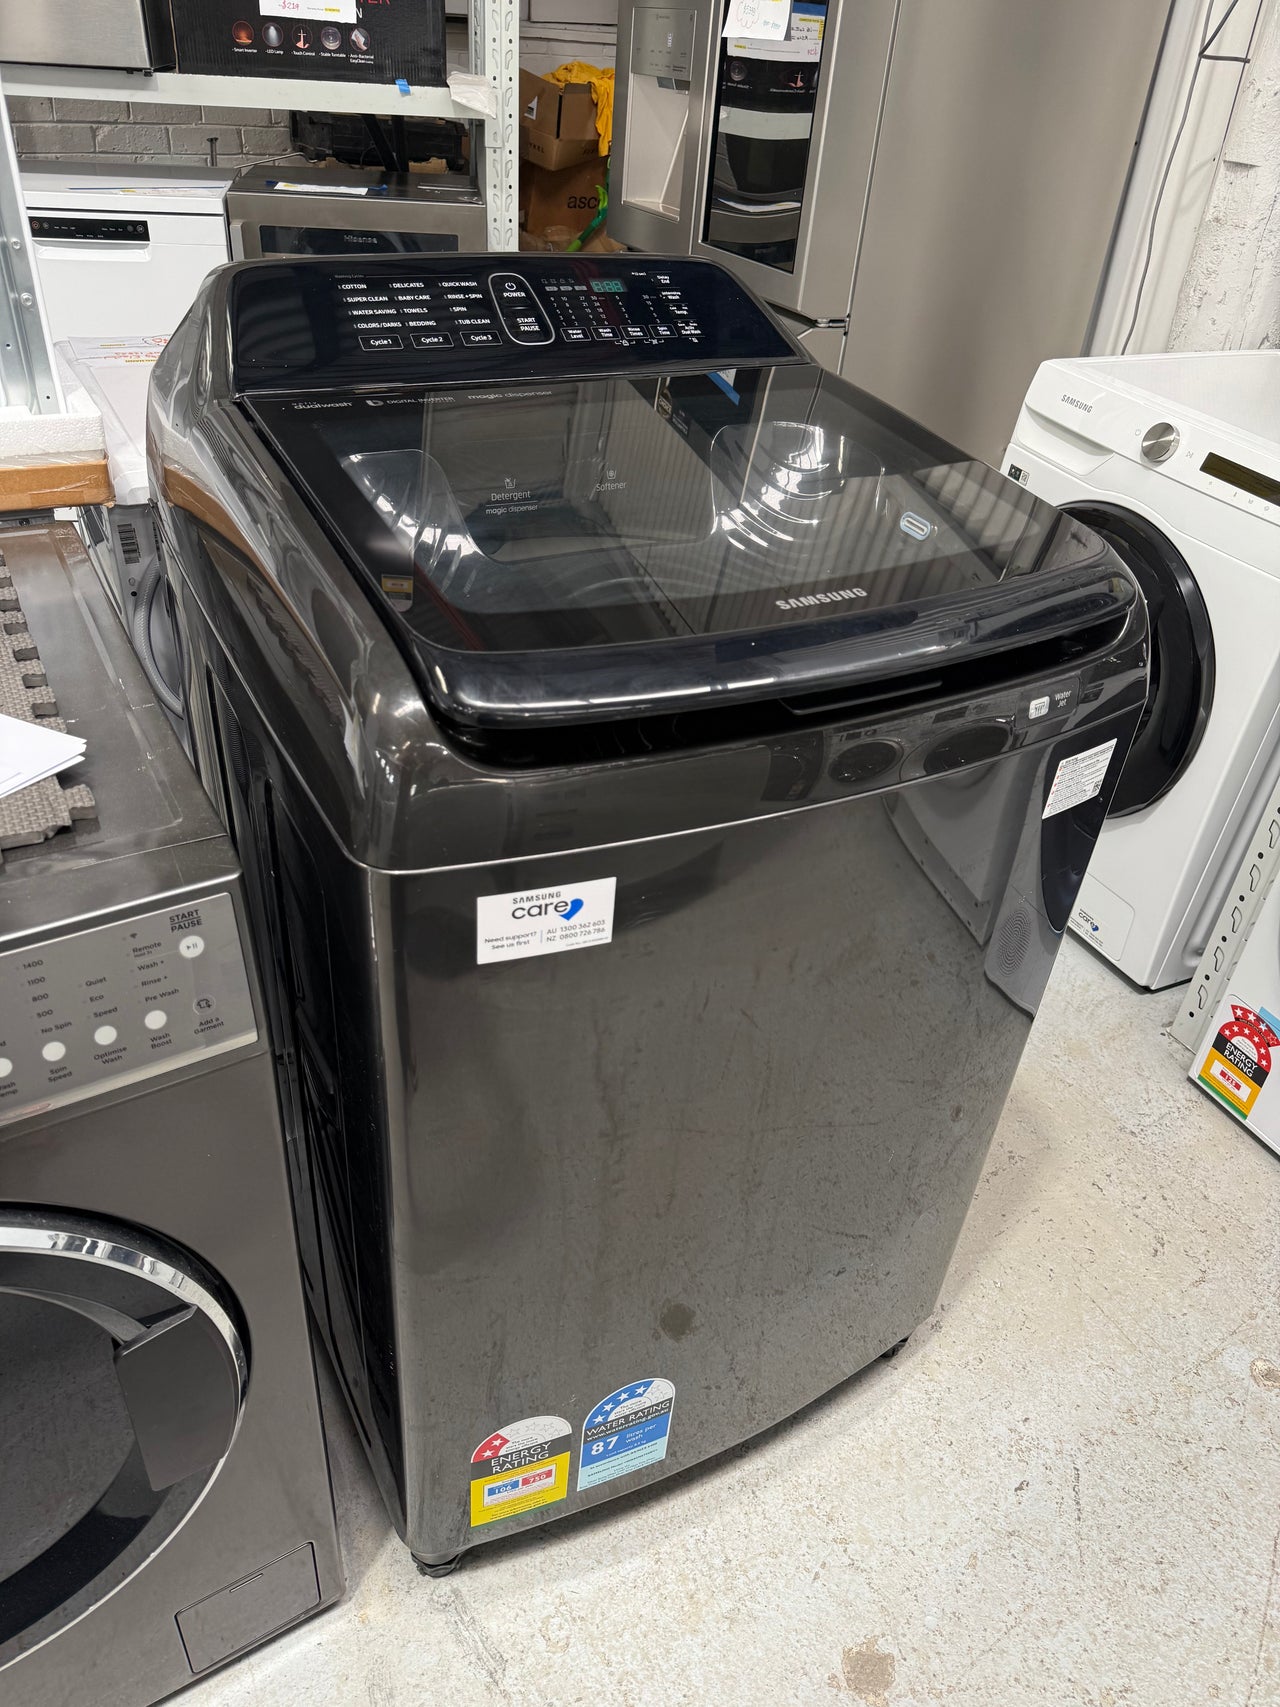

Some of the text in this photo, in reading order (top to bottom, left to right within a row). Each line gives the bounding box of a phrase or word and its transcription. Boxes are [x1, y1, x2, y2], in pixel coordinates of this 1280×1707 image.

[567, 195, 600, 209] asc
[370, 338, 388, 346] Cycle
[421, 336, 438, 344] Cycle
[470, 334, 487, 342] Cycle
[417, 396, 455, 404] INVERTER
[504, 390, 553, 399] dispenser
[1061, 394, 1093, 414] SAMSUNG
[596, 482, 627, 492] Softener
[491, 490, 531, 501] Detergent
[485, 504, 538, 516] magic dispenser
[775, 587, 869, 610] SAMSUNG
[1055, 690, 1072, 701] Water
[1057, 699, 1067, 708] Jet
[512, 891, 562, 905] SAMSUNG
[169, 908, 201, 923] START
[511, 900, 569, 920] care
[171, 918, 203, 933] PAUSE
[559, 924, 577, 933] 1300
[578, 922, 591, 930] 362
[592, 919, 606, 927] 603
[484, 931, 537, 944] Need support?
[559, 932, 578, 940] 0800
[579, 929, 592, 937] 726
[132, 941, 162, 954] Remote
[516, 939, 530, 947] first
[22, 959, 44, 970] 1400
[137, 961, 159, 972] Wash
[27, 976, 46, 987] 1100
[85, 976, 107, 987] Quiet
[141, 977, 162, 987] Rinse
[31, 993, 49, 1002] 800
[89, 993, 104, 1003] Eco
[144, 988, 180, 1003] Pre Wash
[93, 1006, 118, 1019] Speed
[41, 1020, 73, 1034] No Spin
[193, 1020, 225, 1035] Garment
[199, 1017, 214, 1027] Add
[150, 1032, 171, 1043] Wash
[150, 1039, 172, 1050] Boost
[93, 1046, 128, 1061] Optimise
[1225, 1042, 1258, 1071] ENERGY
[101, 1054, 123, 1065] Wash
[1223, 1049, 1254, 1078] RATING
[49, 1065, 68, 1075] Spin
[47, 1071, 73, 1083] Speed
[0, 1089, 19, 1098] emp
[586, 1400, 670, 1436] WATER RATING
[626, 1423, 657, 1439] litres per
[625, 1434, 643, 1444] wash
[591, 1435, 620, 1456] 87
[491, 1441, 552, 1467] ENERGY
[492, 1450, 550, 1474] RATING
[495, 1485, 512, 1494] 106
[529, 1474, 546, 1484] 750
